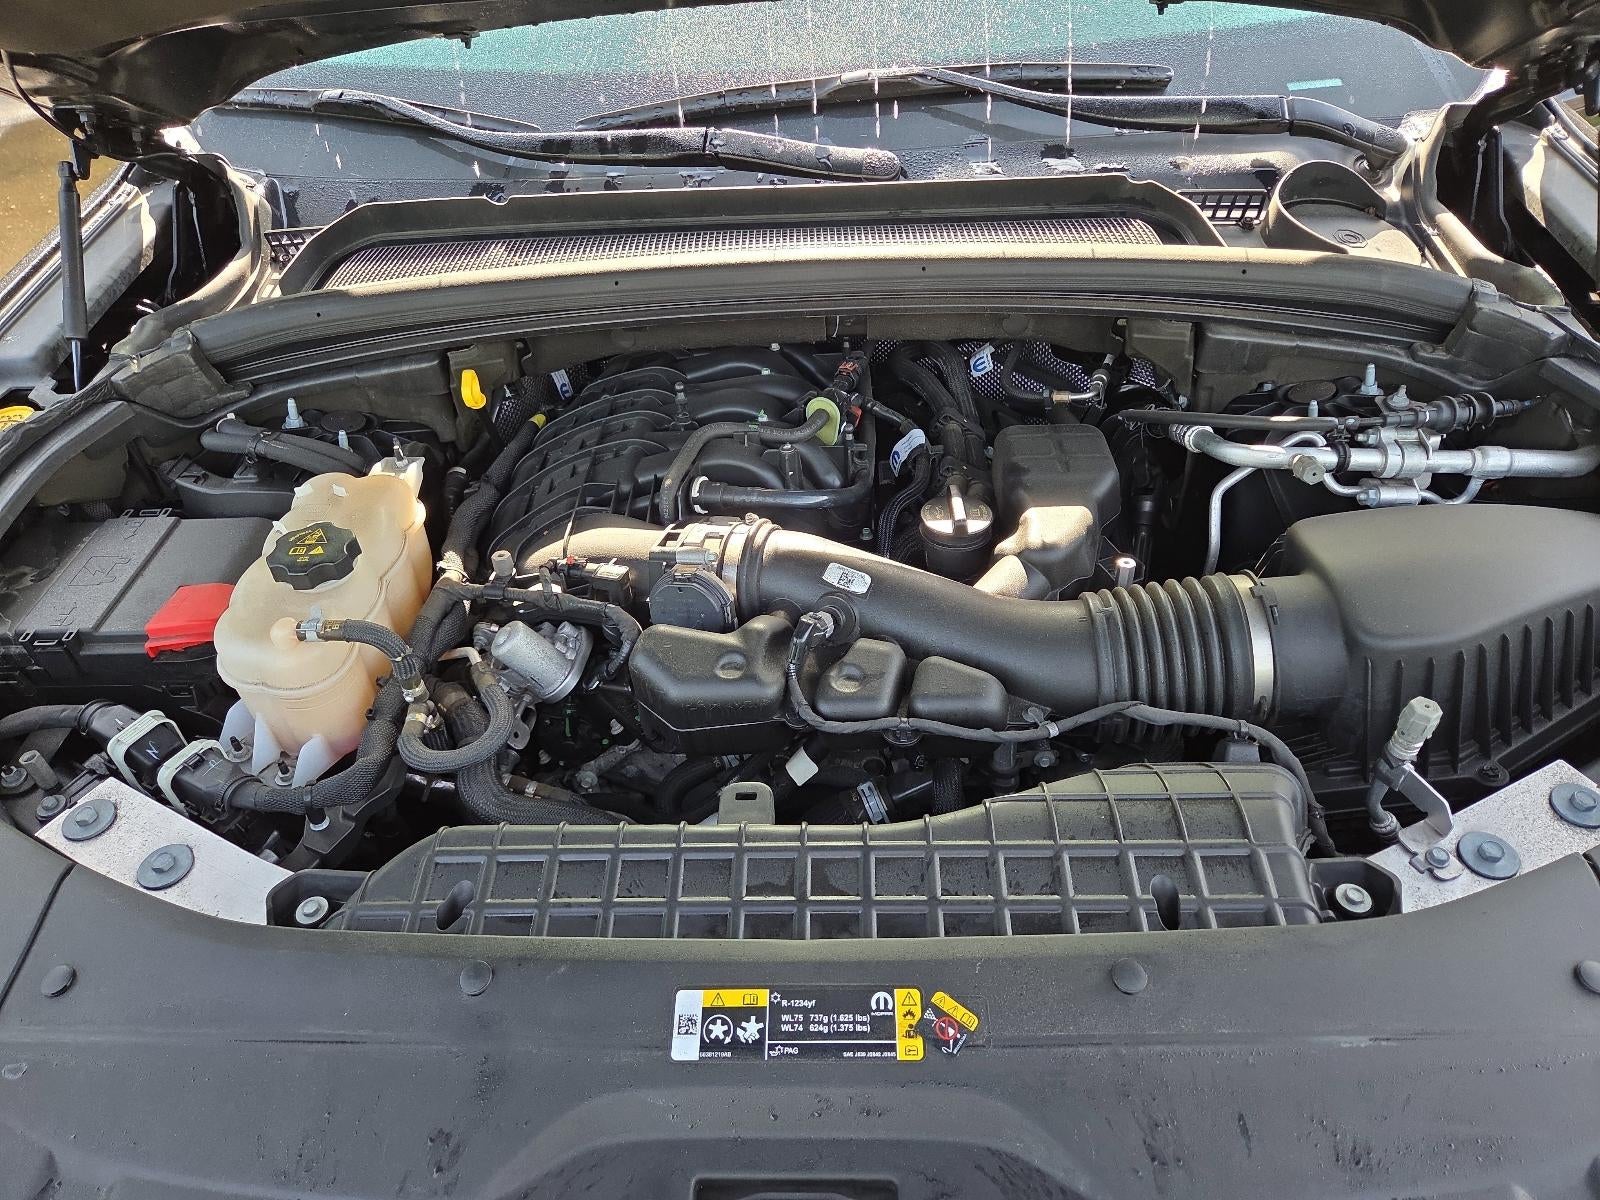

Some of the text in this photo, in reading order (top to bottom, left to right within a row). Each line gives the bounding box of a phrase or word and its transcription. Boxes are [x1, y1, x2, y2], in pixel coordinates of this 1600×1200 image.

[781, 999, 817, 1009] R-1234yf
[781, 1014, 871, 1023] WL75 737g (1.625 lbs)
[781, 1024, 871, 1033] WL74 624g (1.375 lbs)
[784, 1046, 799, 1055] PAG
